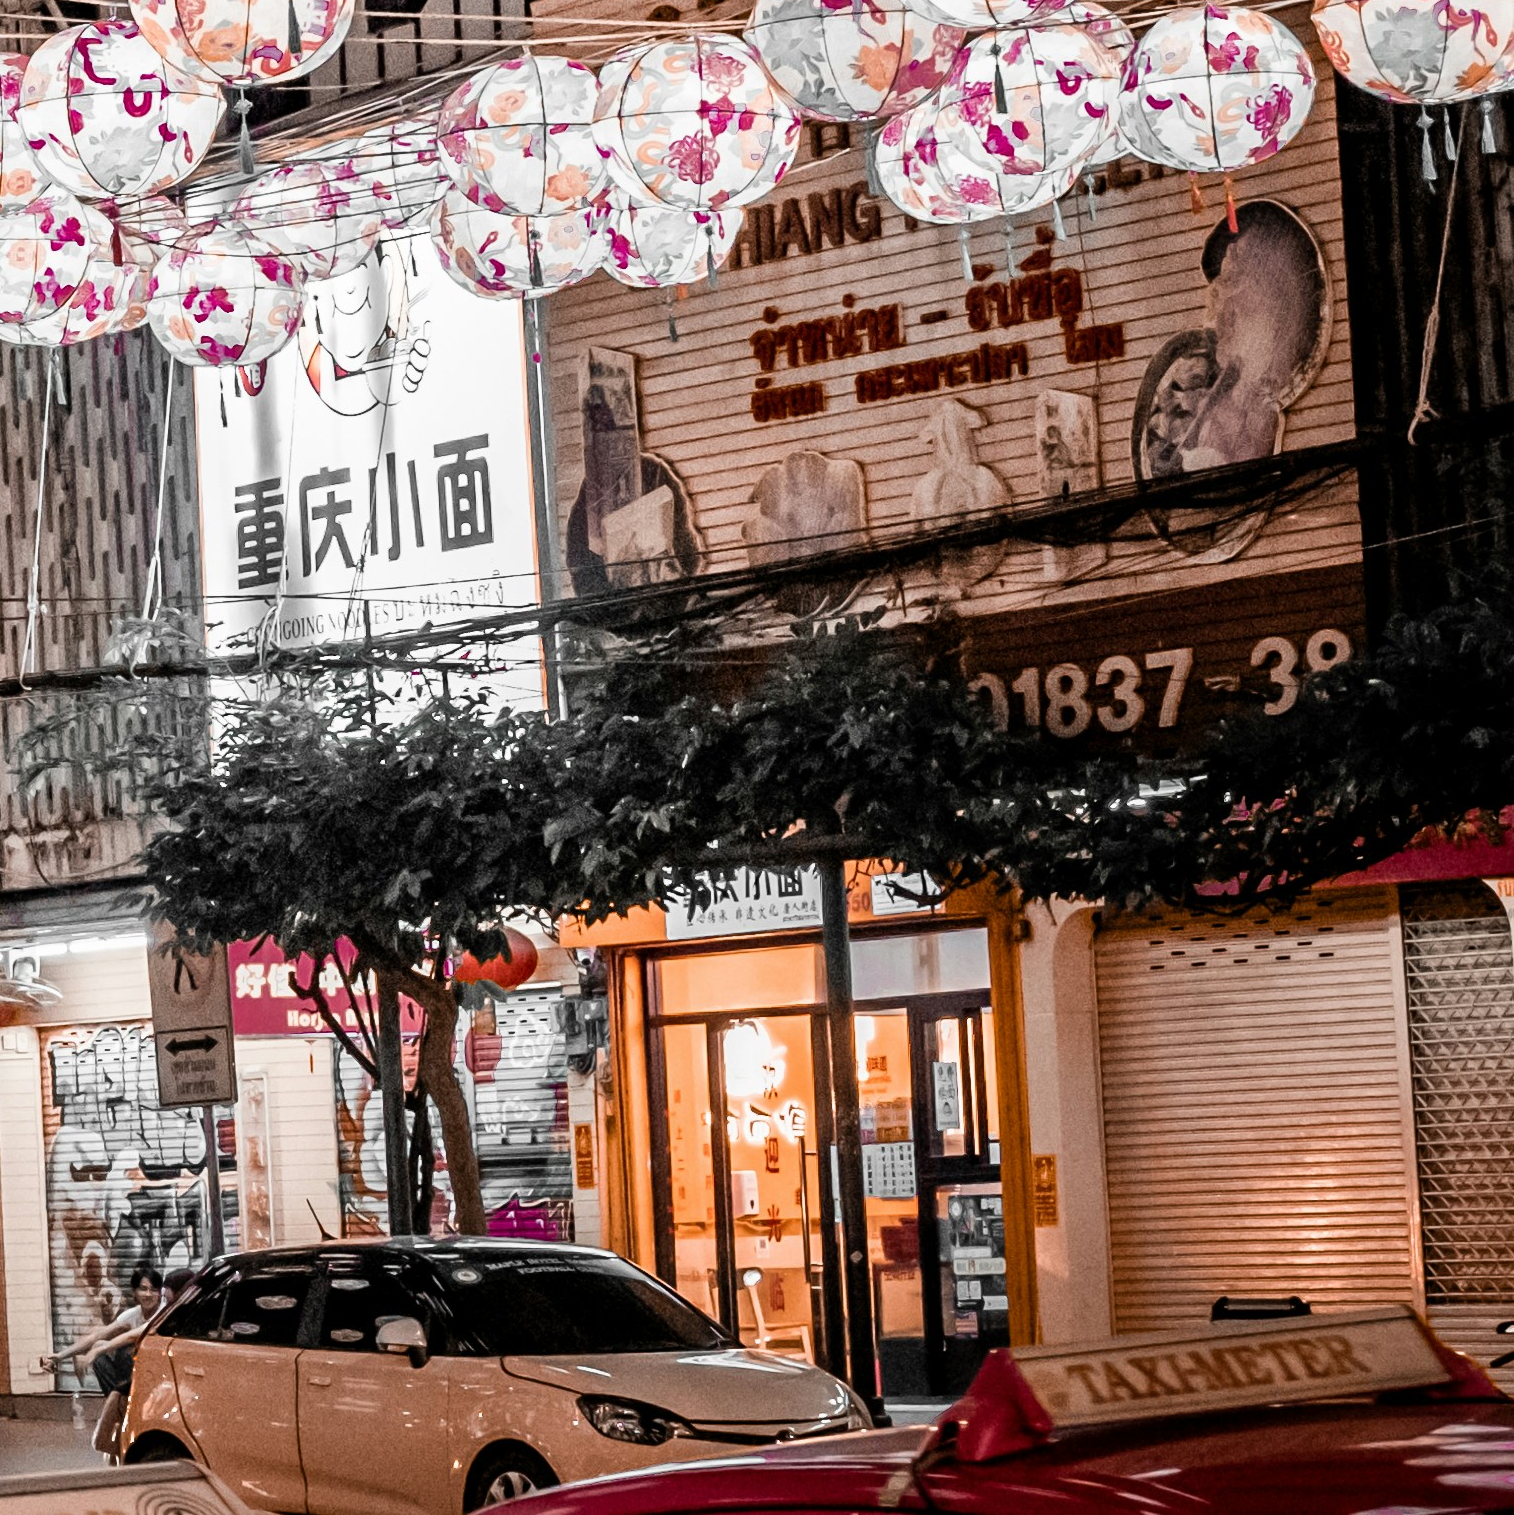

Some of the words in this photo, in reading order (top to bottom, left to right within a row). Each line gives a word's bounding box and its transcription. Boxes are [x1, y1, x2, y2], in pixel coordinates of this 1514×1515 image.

[234, 433, 495, 590] 重庆小面
[1065, 1334, 1370, 1405] TAXI-METER
